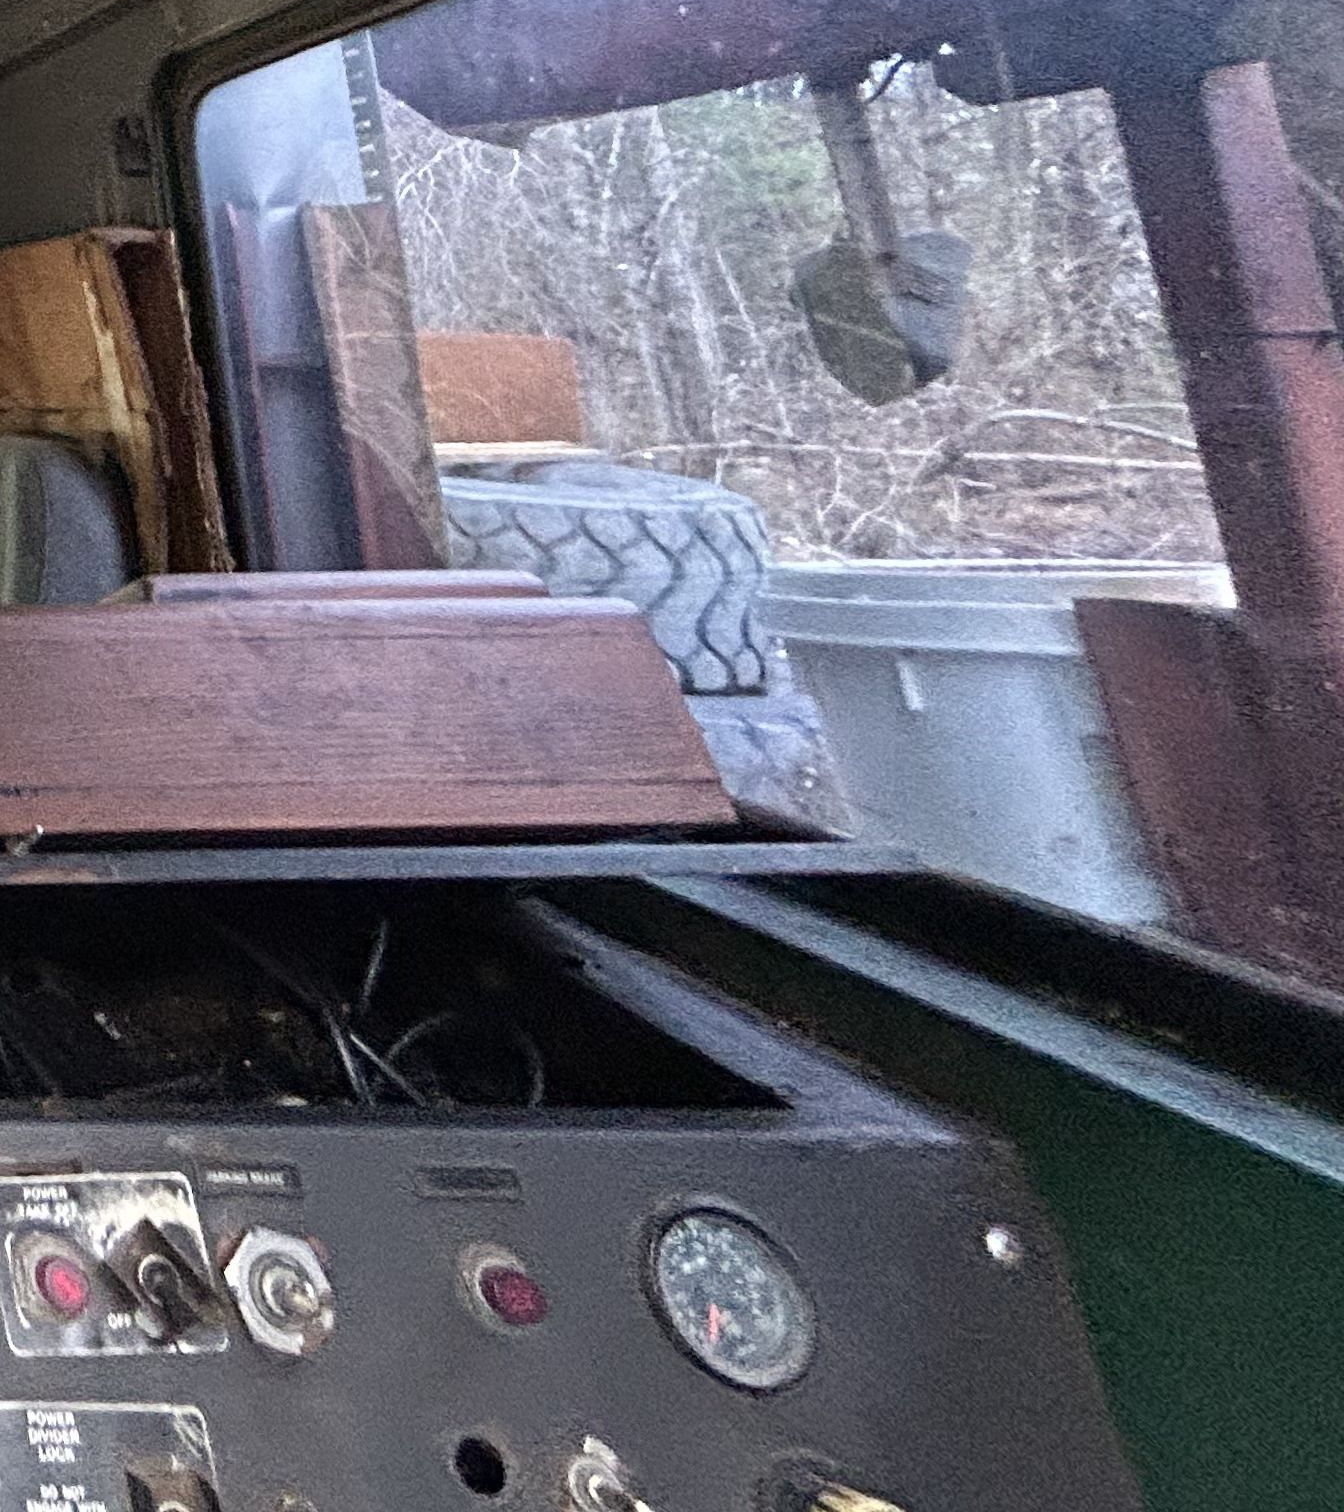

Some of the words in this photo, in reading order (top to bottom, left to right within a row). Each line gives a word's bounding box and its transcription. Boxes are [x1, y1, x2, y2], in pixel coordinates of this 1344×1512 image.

[23, 1186, 68, 1201] POWER
[107, 1312, 132, 1329] OFF
[27, 1410, 75, 1426] POWER
[27, 1427, 81, 1445] DIVIDER
[38, 1445, 75, 1463] LOCK
[40, 1484, 59, 1500] DO
[61, 1484, 85, 1501] NOT
